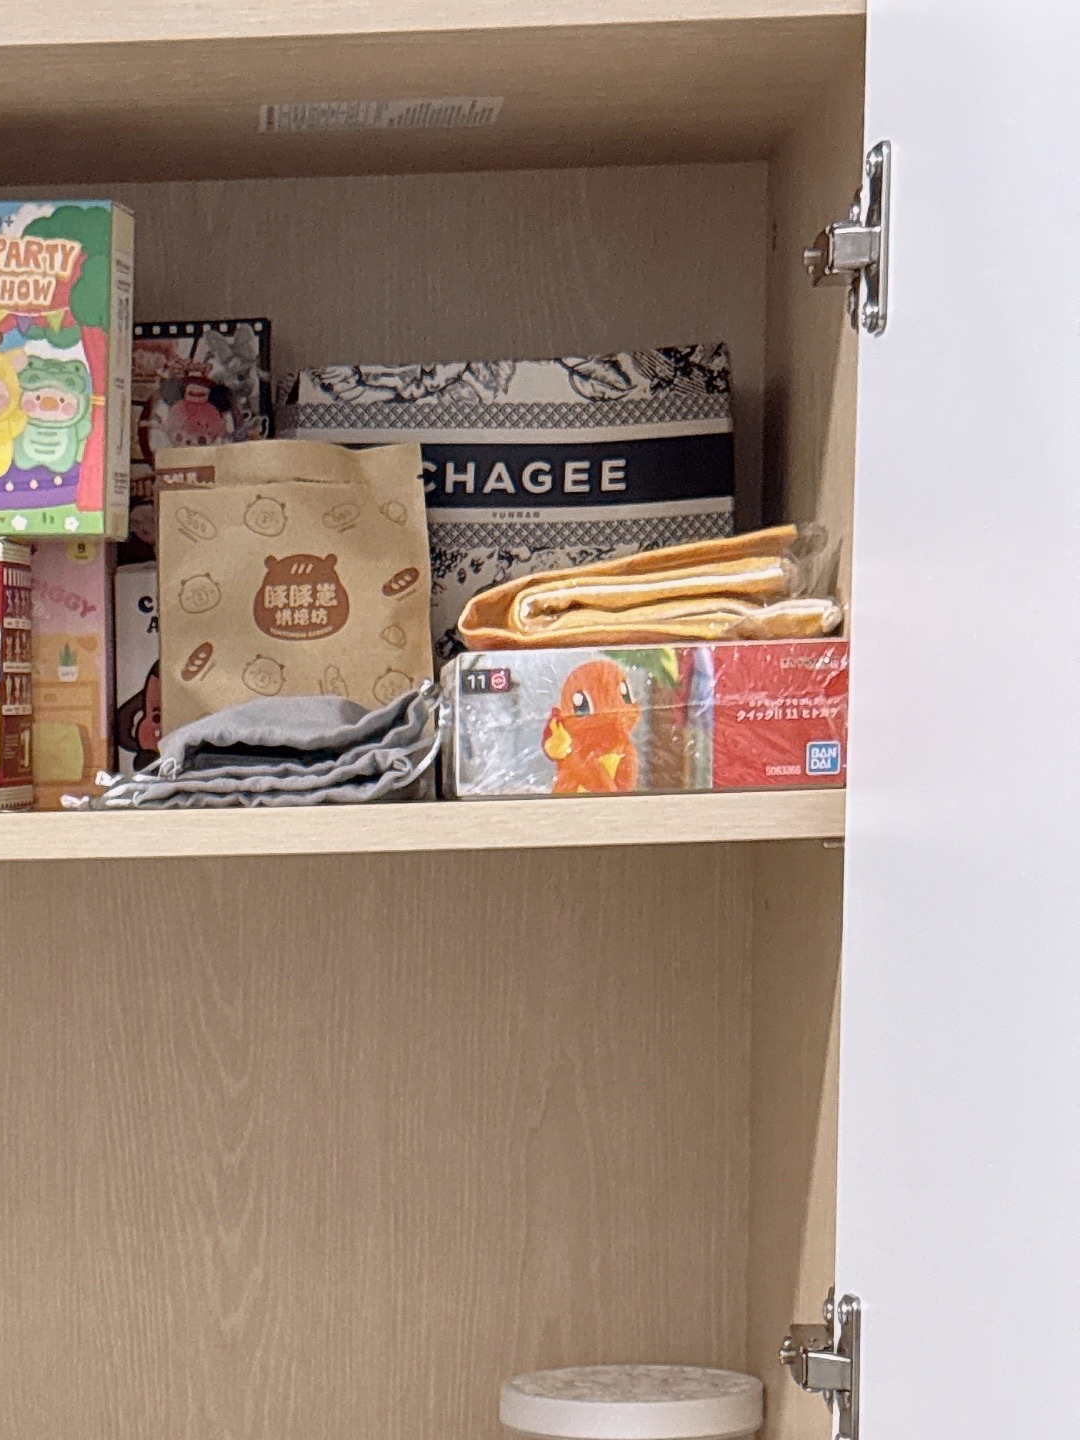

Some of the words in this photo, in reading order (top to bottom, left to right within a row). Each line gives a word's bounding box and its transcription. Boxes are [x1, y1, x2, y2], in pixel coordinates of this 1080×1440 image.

[423, 458, 628, 495] CHAGEE
[467, 672, 486, 690] 11
[811, 746, 838, 759] BAN
[811, 758, 832, 770] DAI
